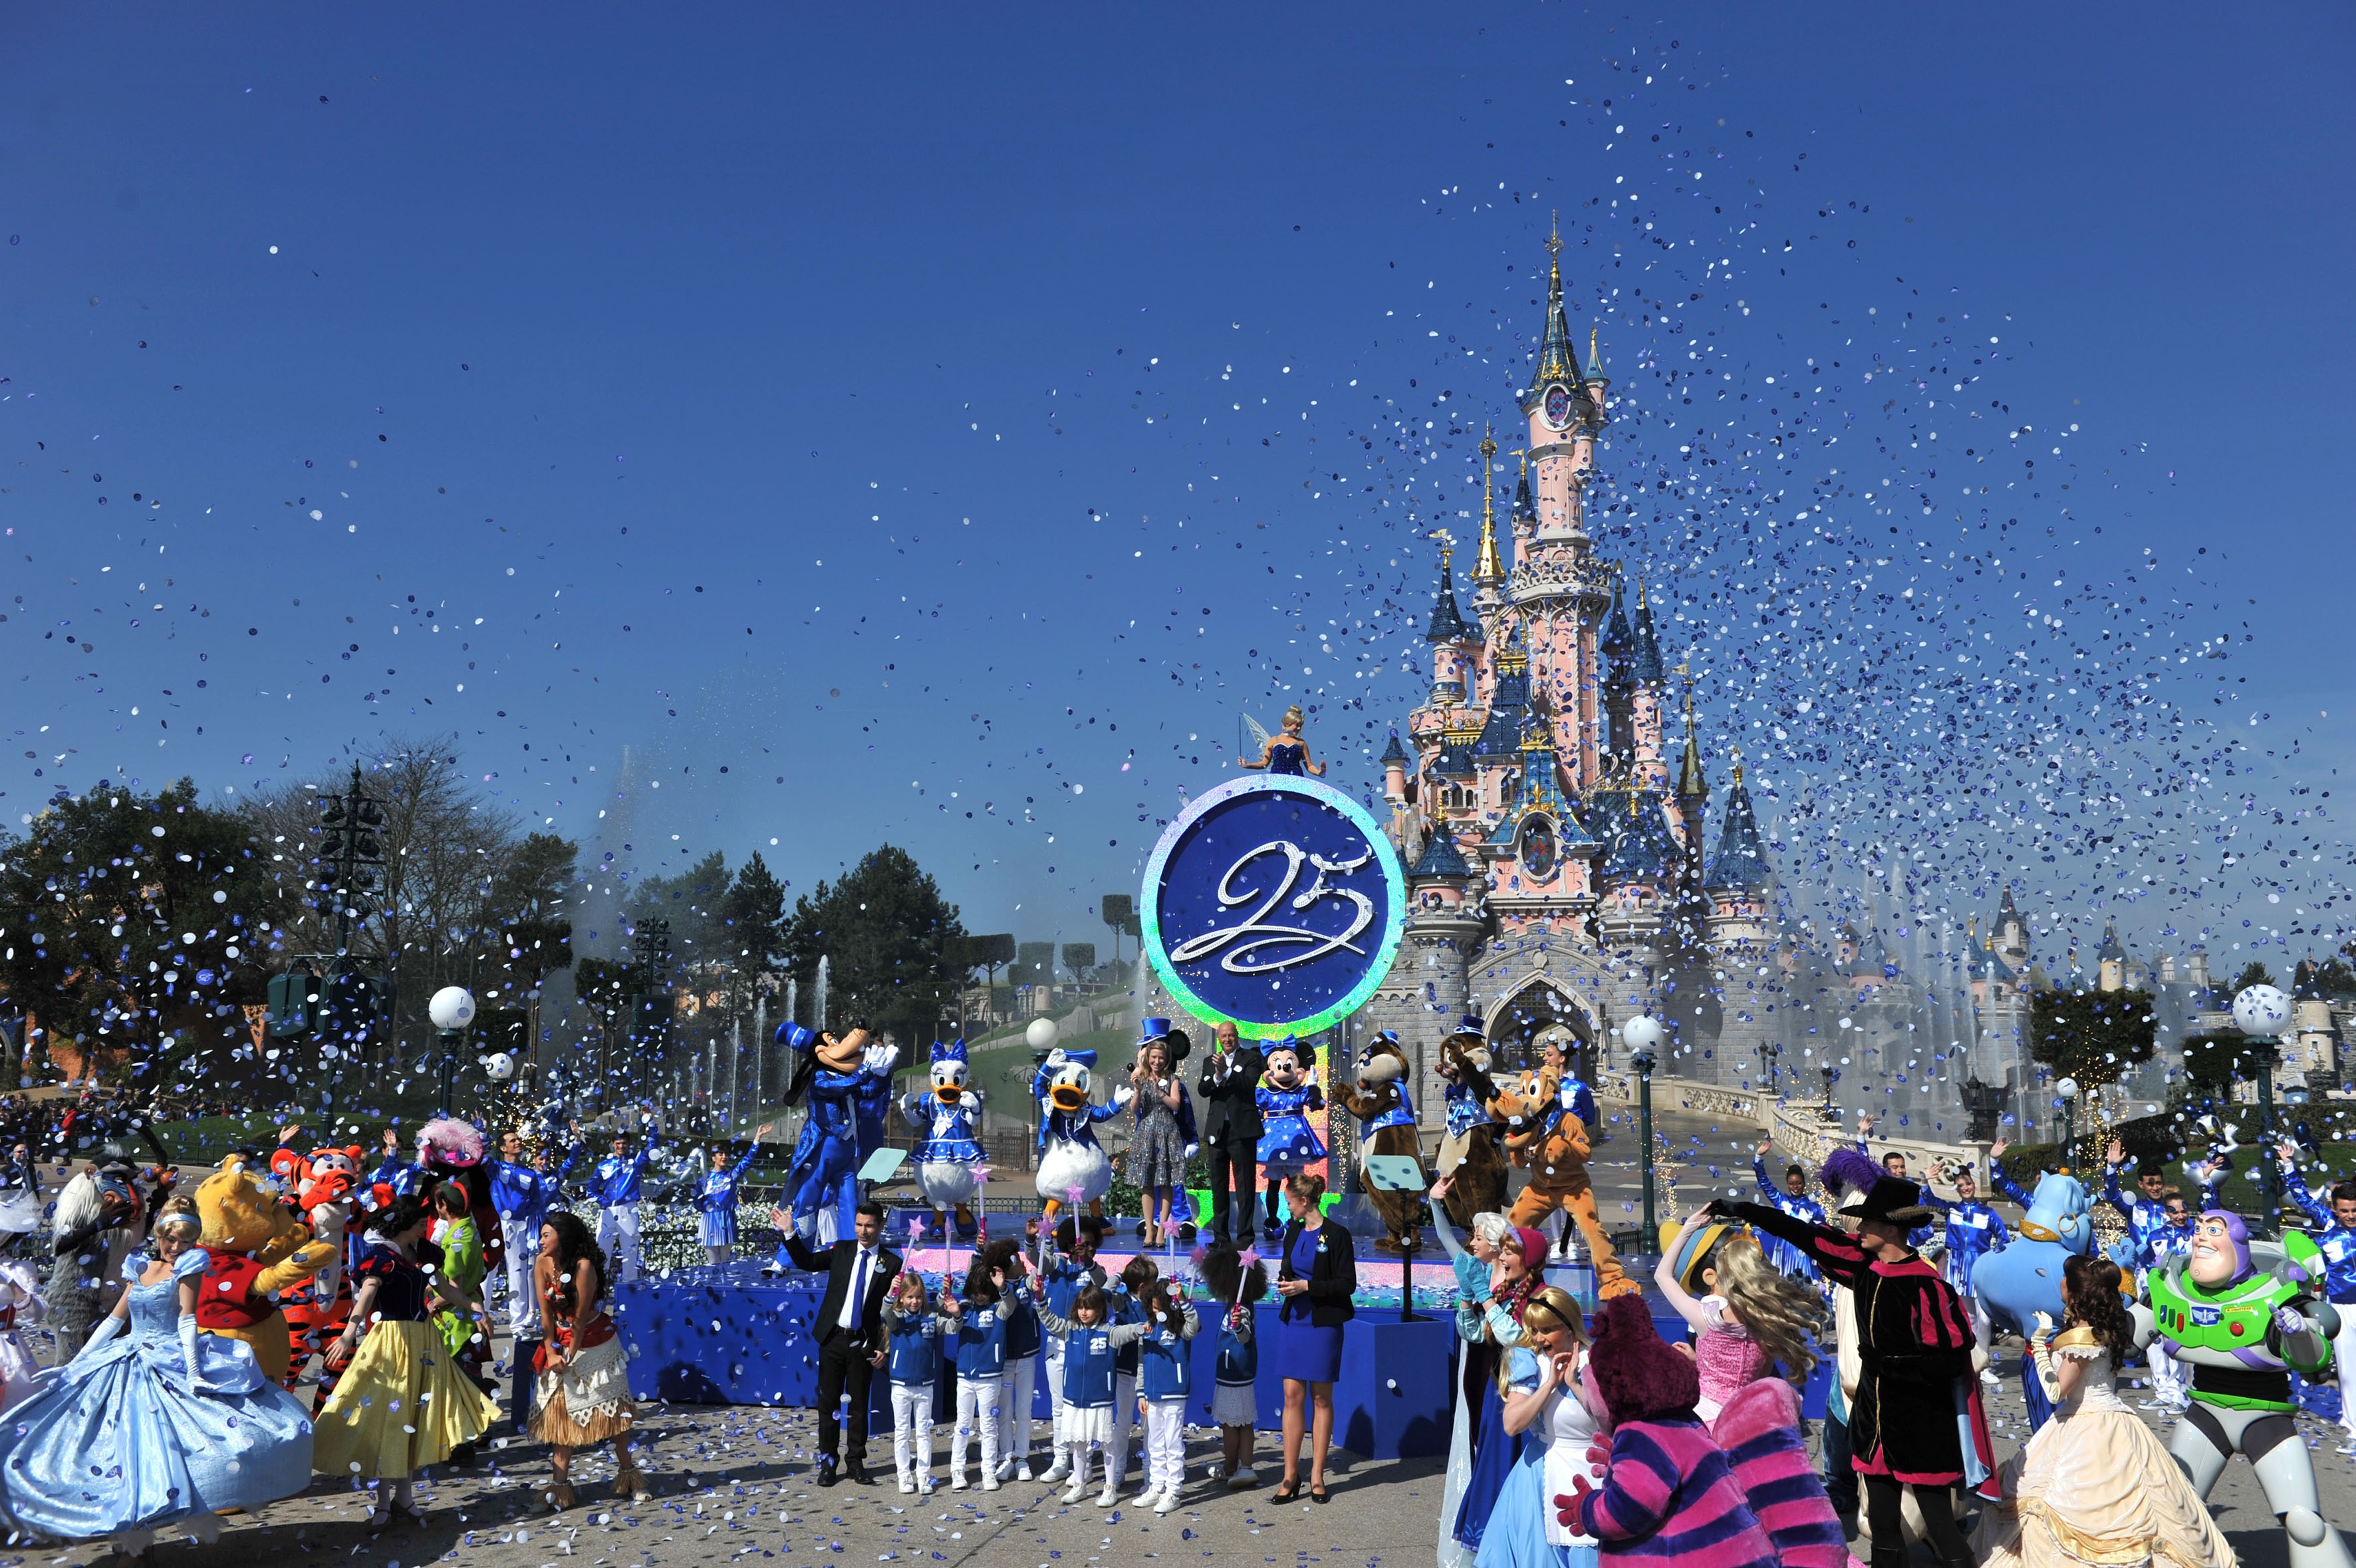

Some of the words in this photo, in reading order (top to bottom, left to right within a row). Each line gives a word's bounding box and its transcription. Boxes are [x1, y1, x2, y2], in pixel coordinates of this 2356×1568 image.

[1170, 841, 1374, 972] 25
[978, 1310, 993, 1322] 25
[920, 1321, 935, 1333] 25
[1090, 1337, 1107, 1349] 25
